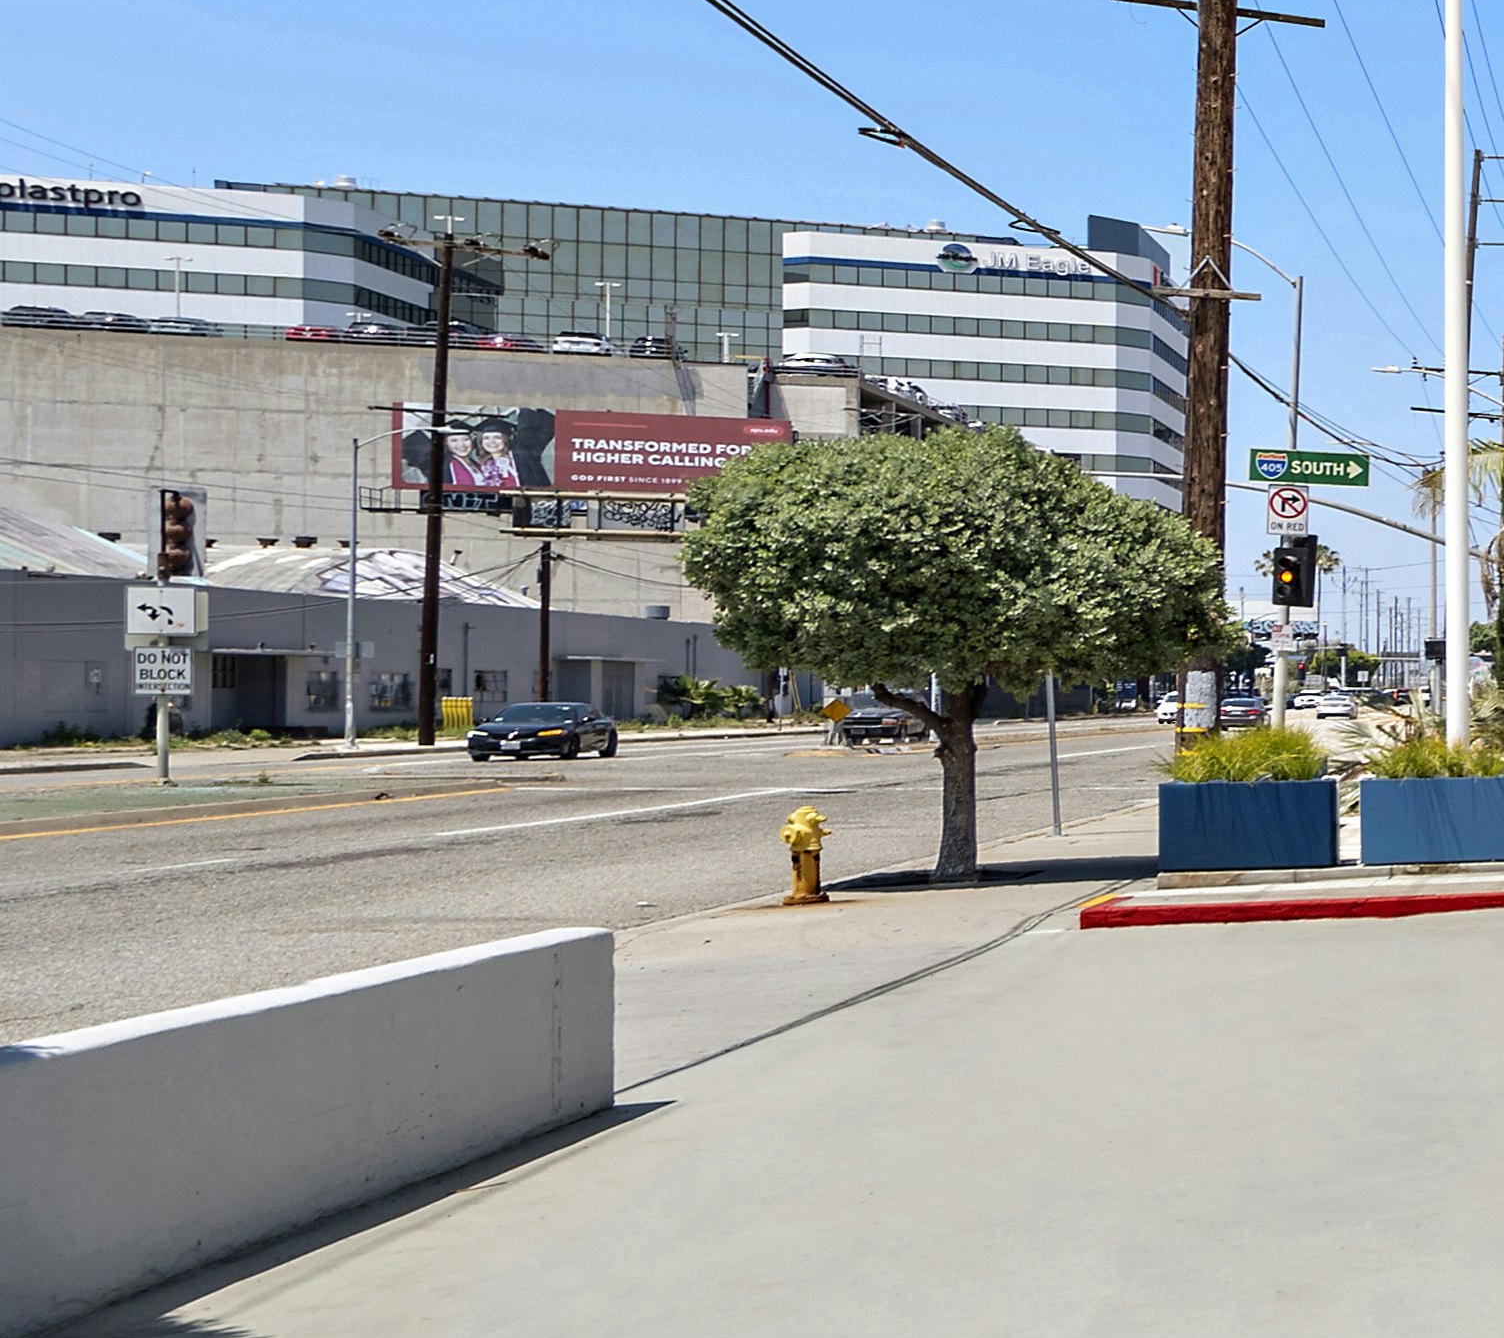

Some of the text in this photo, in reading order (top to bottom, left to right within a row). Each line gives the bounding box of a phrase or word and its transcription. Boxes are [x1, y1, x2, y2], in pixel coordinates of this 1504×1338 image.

[983, 251, 1018, 269] JM
[1026, 253, 1091, 276] Eagle
[571, 438, 711, 454] TRANSFORMED
[572, 452, 644, 464] HIGHER
[1261, 460, 1345, 476] 405 SOUTH
[1271, 522, 1305, 531] ON RED
[137, 653, 188, 664] DO NOT
[140, 668, 186, 680] BLOCK
